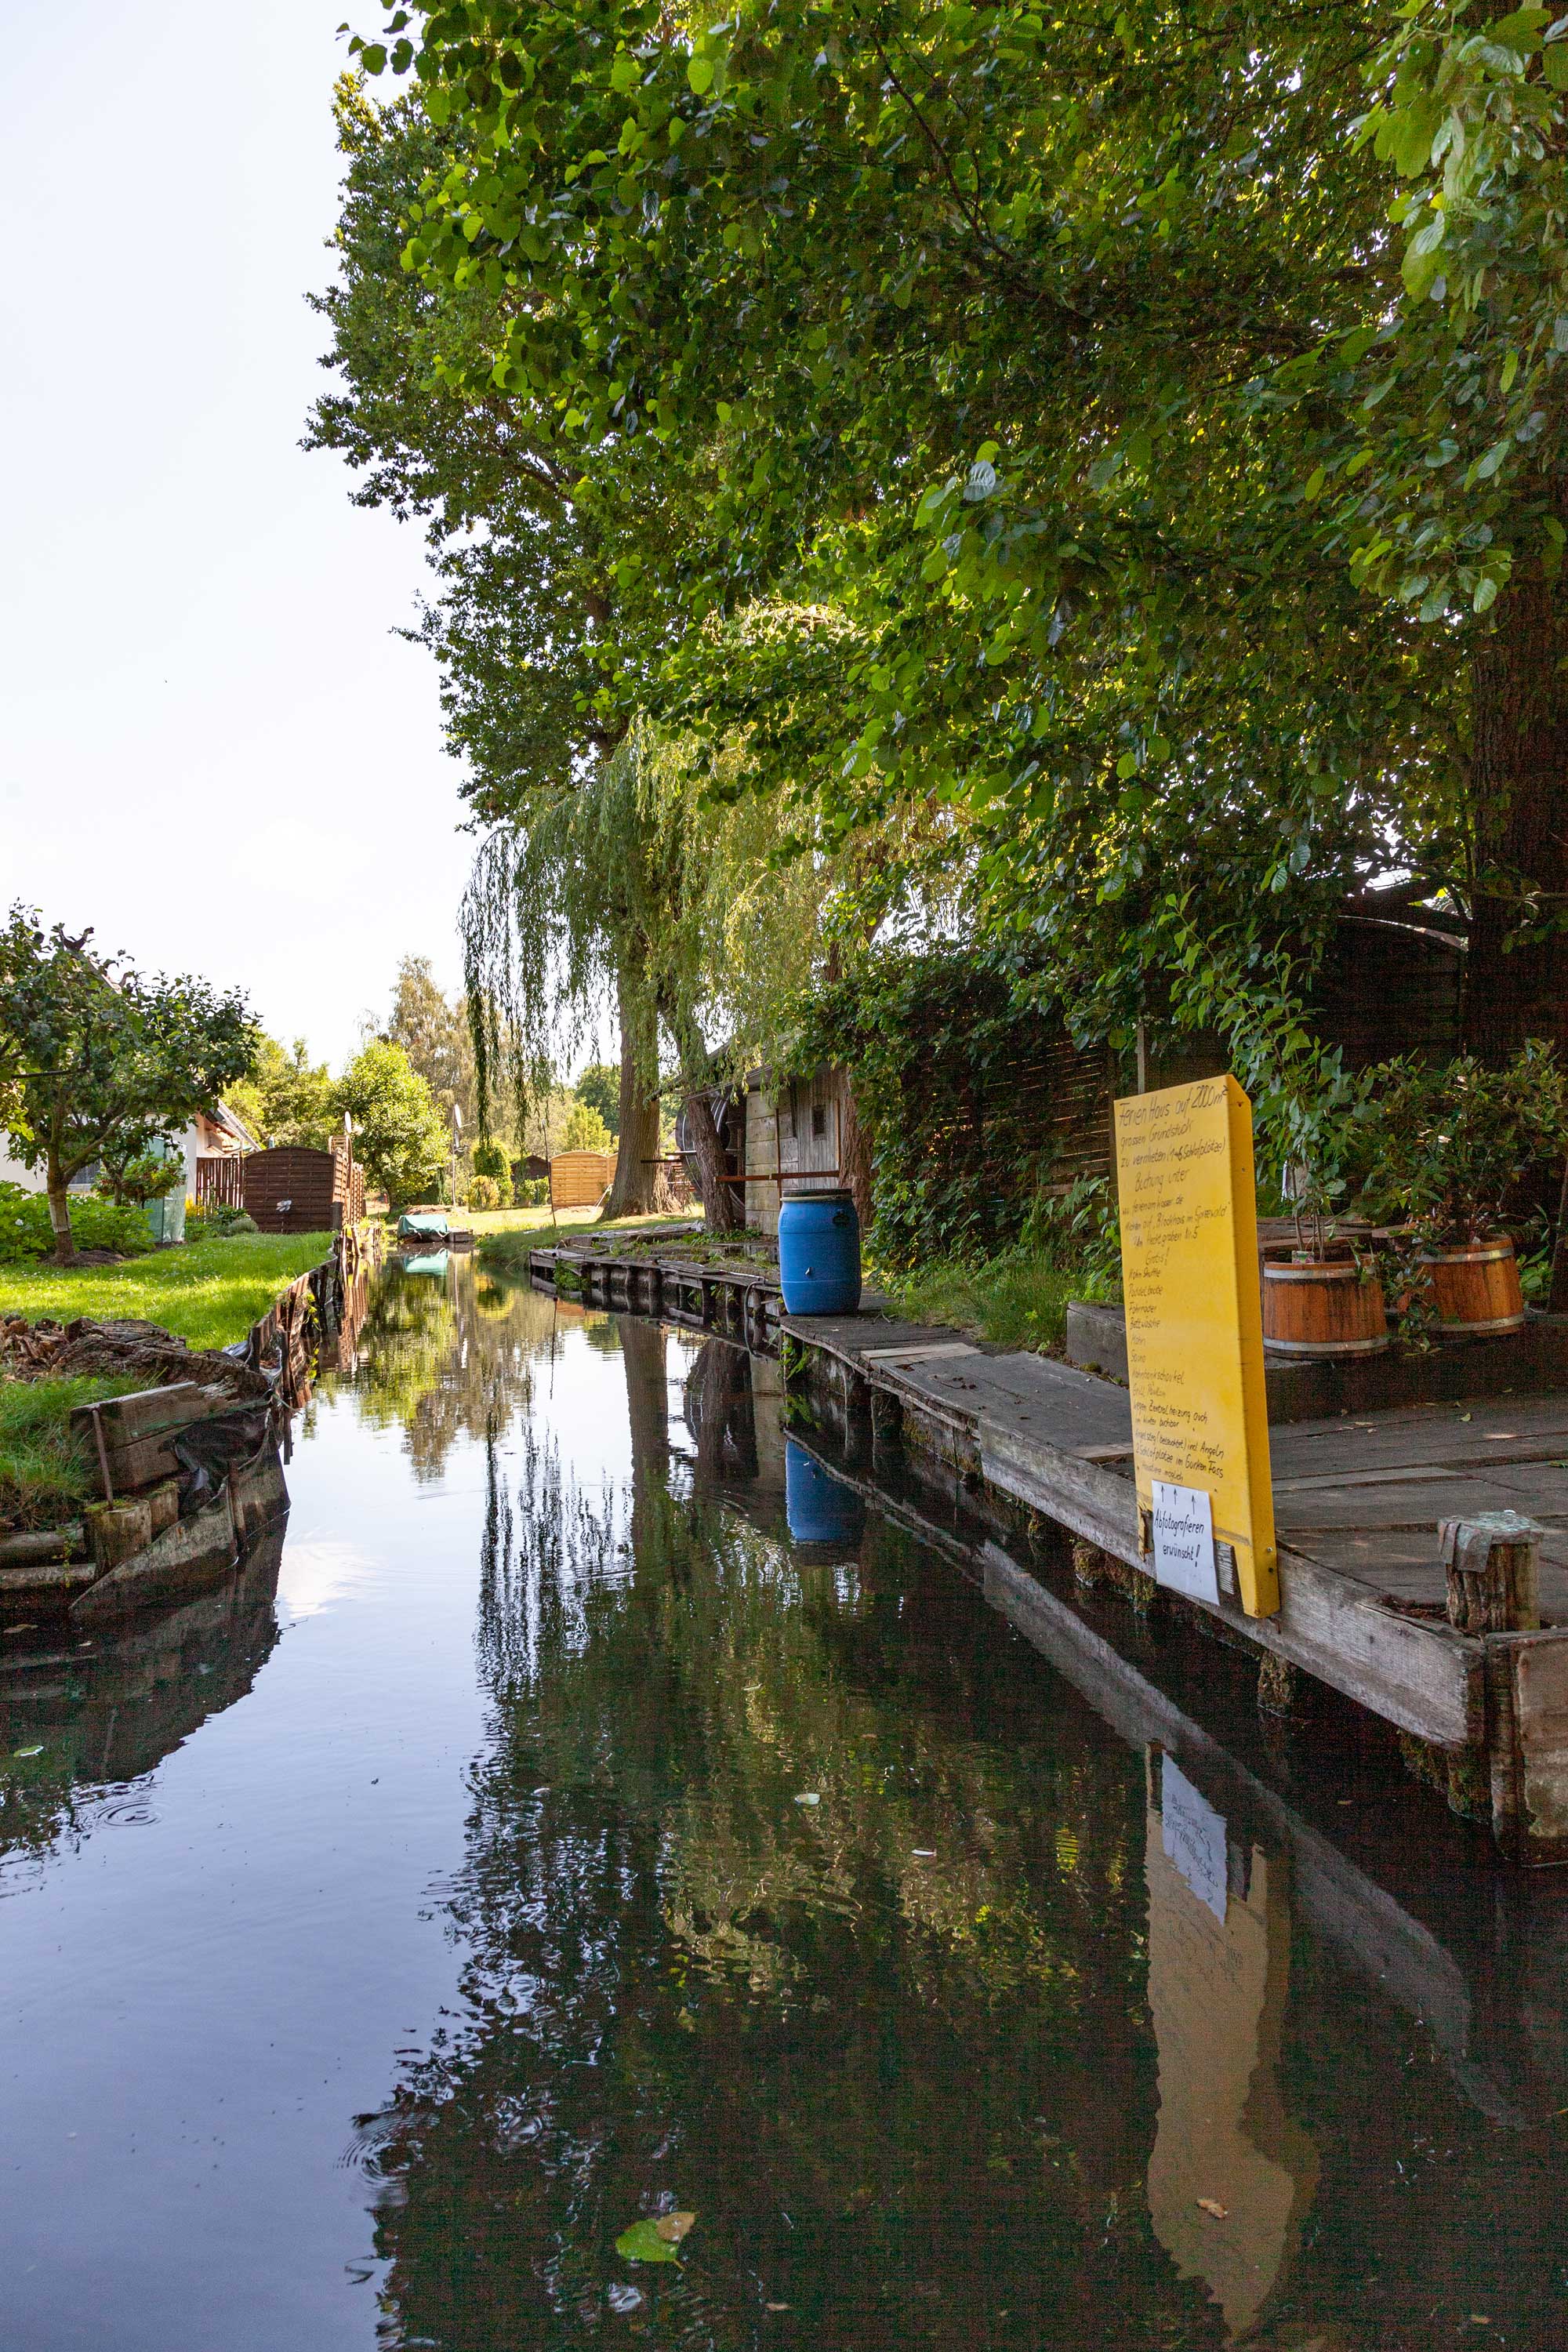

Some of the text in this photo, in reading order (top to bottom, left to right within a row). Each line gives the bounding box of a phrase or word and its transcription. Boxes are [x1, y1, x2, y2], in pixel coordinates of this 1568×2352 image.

[1176, 1087, 1193, 1118] auf
[1120, 1136, 1146, 1155] grossen
[1120, 1158, 1129, 1167] zu
[1133, 1148, 1166, 1165] vermieten
[1135, 1167, 1190, 1193] Buchung unter
[1159, 1417, 1179, 1428] buchbar
[1193, 1411, 1208, 1425] auch
[1200, 1440, 1224, 1460] Angeln
[1185, 1454, 1207, 1471] Gurken
[1208, 1460, 1224, 1479] Fass
[1154, 1507, 1204, 1537] Abfotografieren
